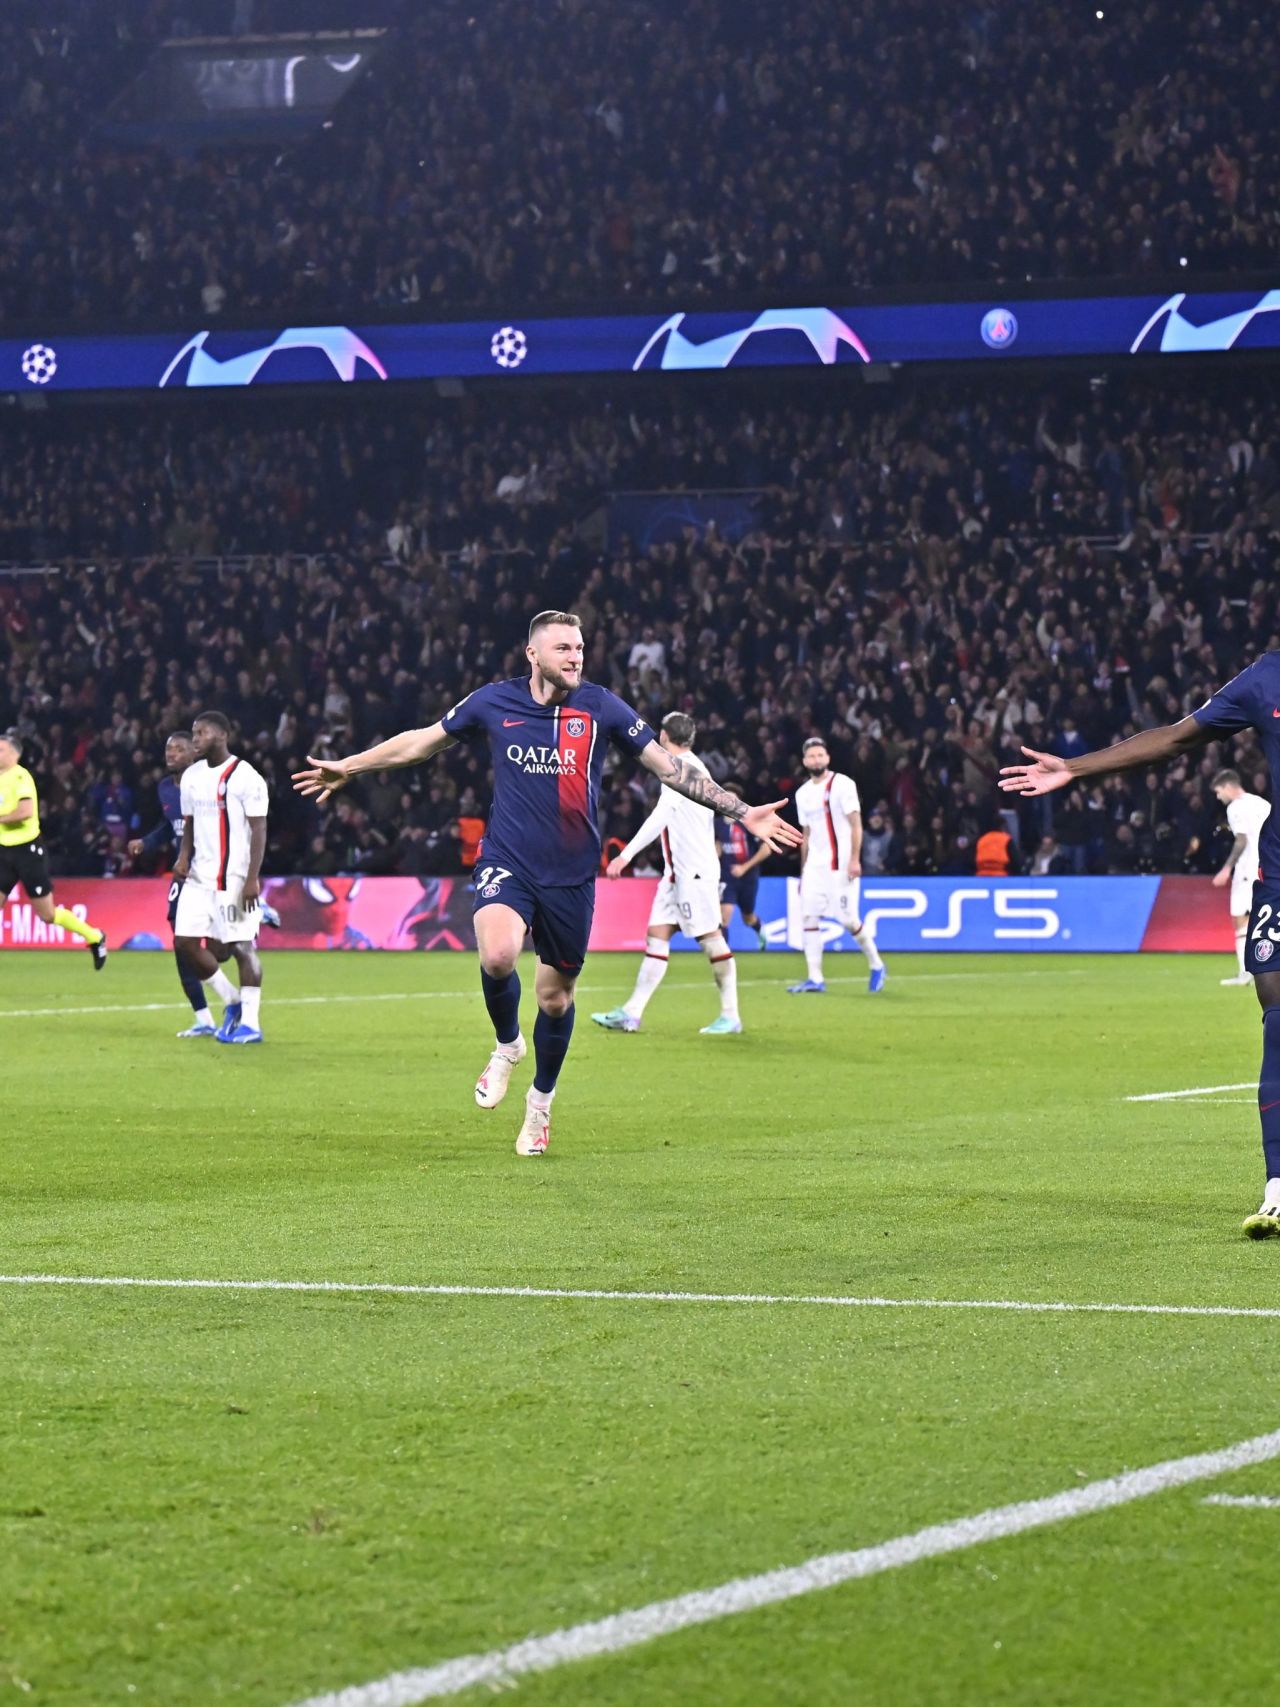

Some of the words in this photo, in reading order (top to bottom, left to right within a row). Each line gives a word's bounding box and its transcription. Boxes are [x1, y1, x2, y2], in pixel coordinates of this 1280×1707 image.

[507, 744, 576, 765] QATAR
[523, 763, 576, 775] AIRWAYS
[476, 866, 513, 890] 37
[0, 904, 65, 944] -MAN
[863, 889, 1060, 939] PS5
